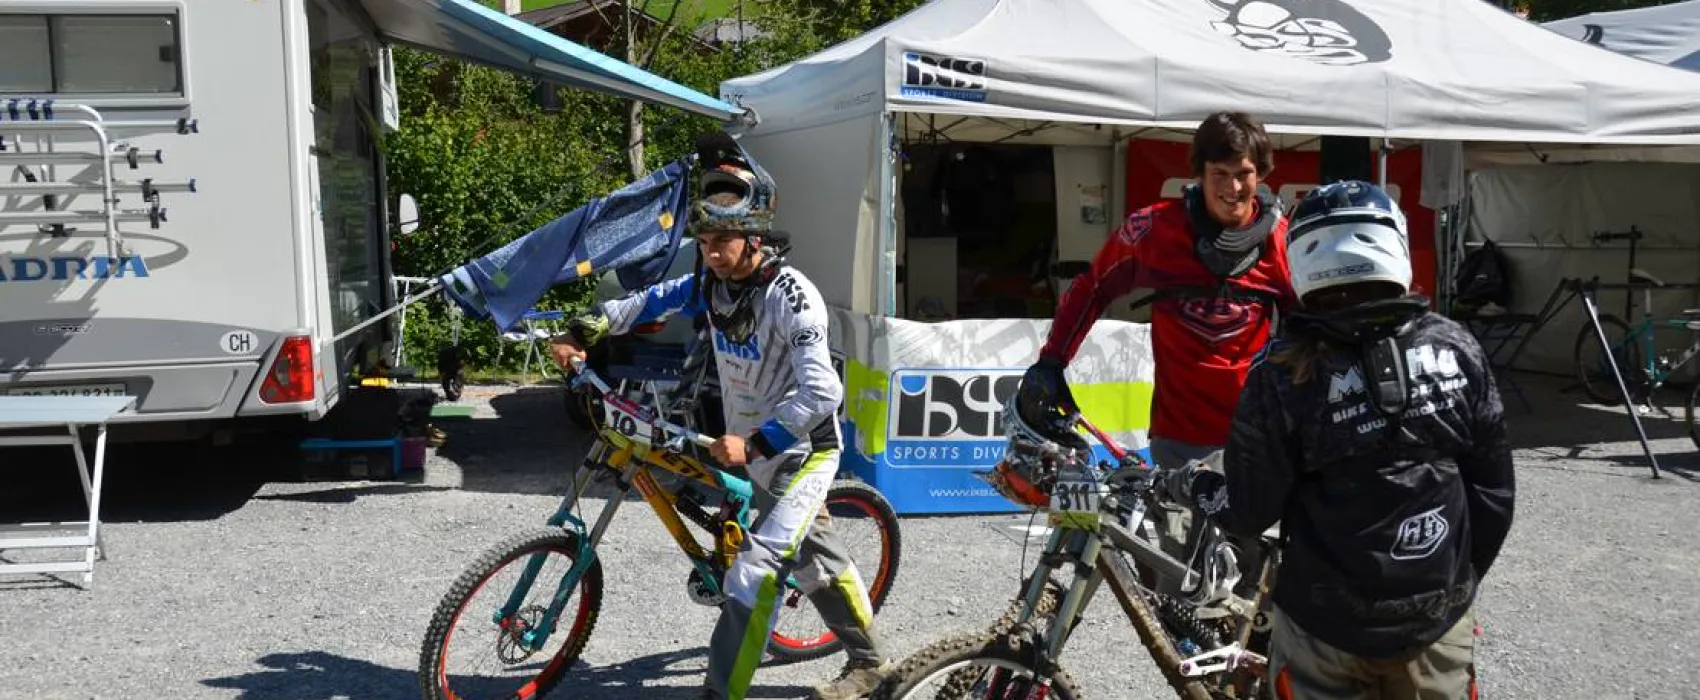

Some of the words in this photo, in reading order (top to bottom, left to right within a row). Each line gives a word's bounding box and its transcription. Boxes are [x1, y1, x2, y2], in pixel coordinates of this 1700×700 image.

[229, 333, 250, 351] CH
[611, 409, 637, 437] 10
[893, 446, 960, 460] SPORTS
[973, 446, 1007, 460] DIVI
[1058, 483, 1091, 511] 311
